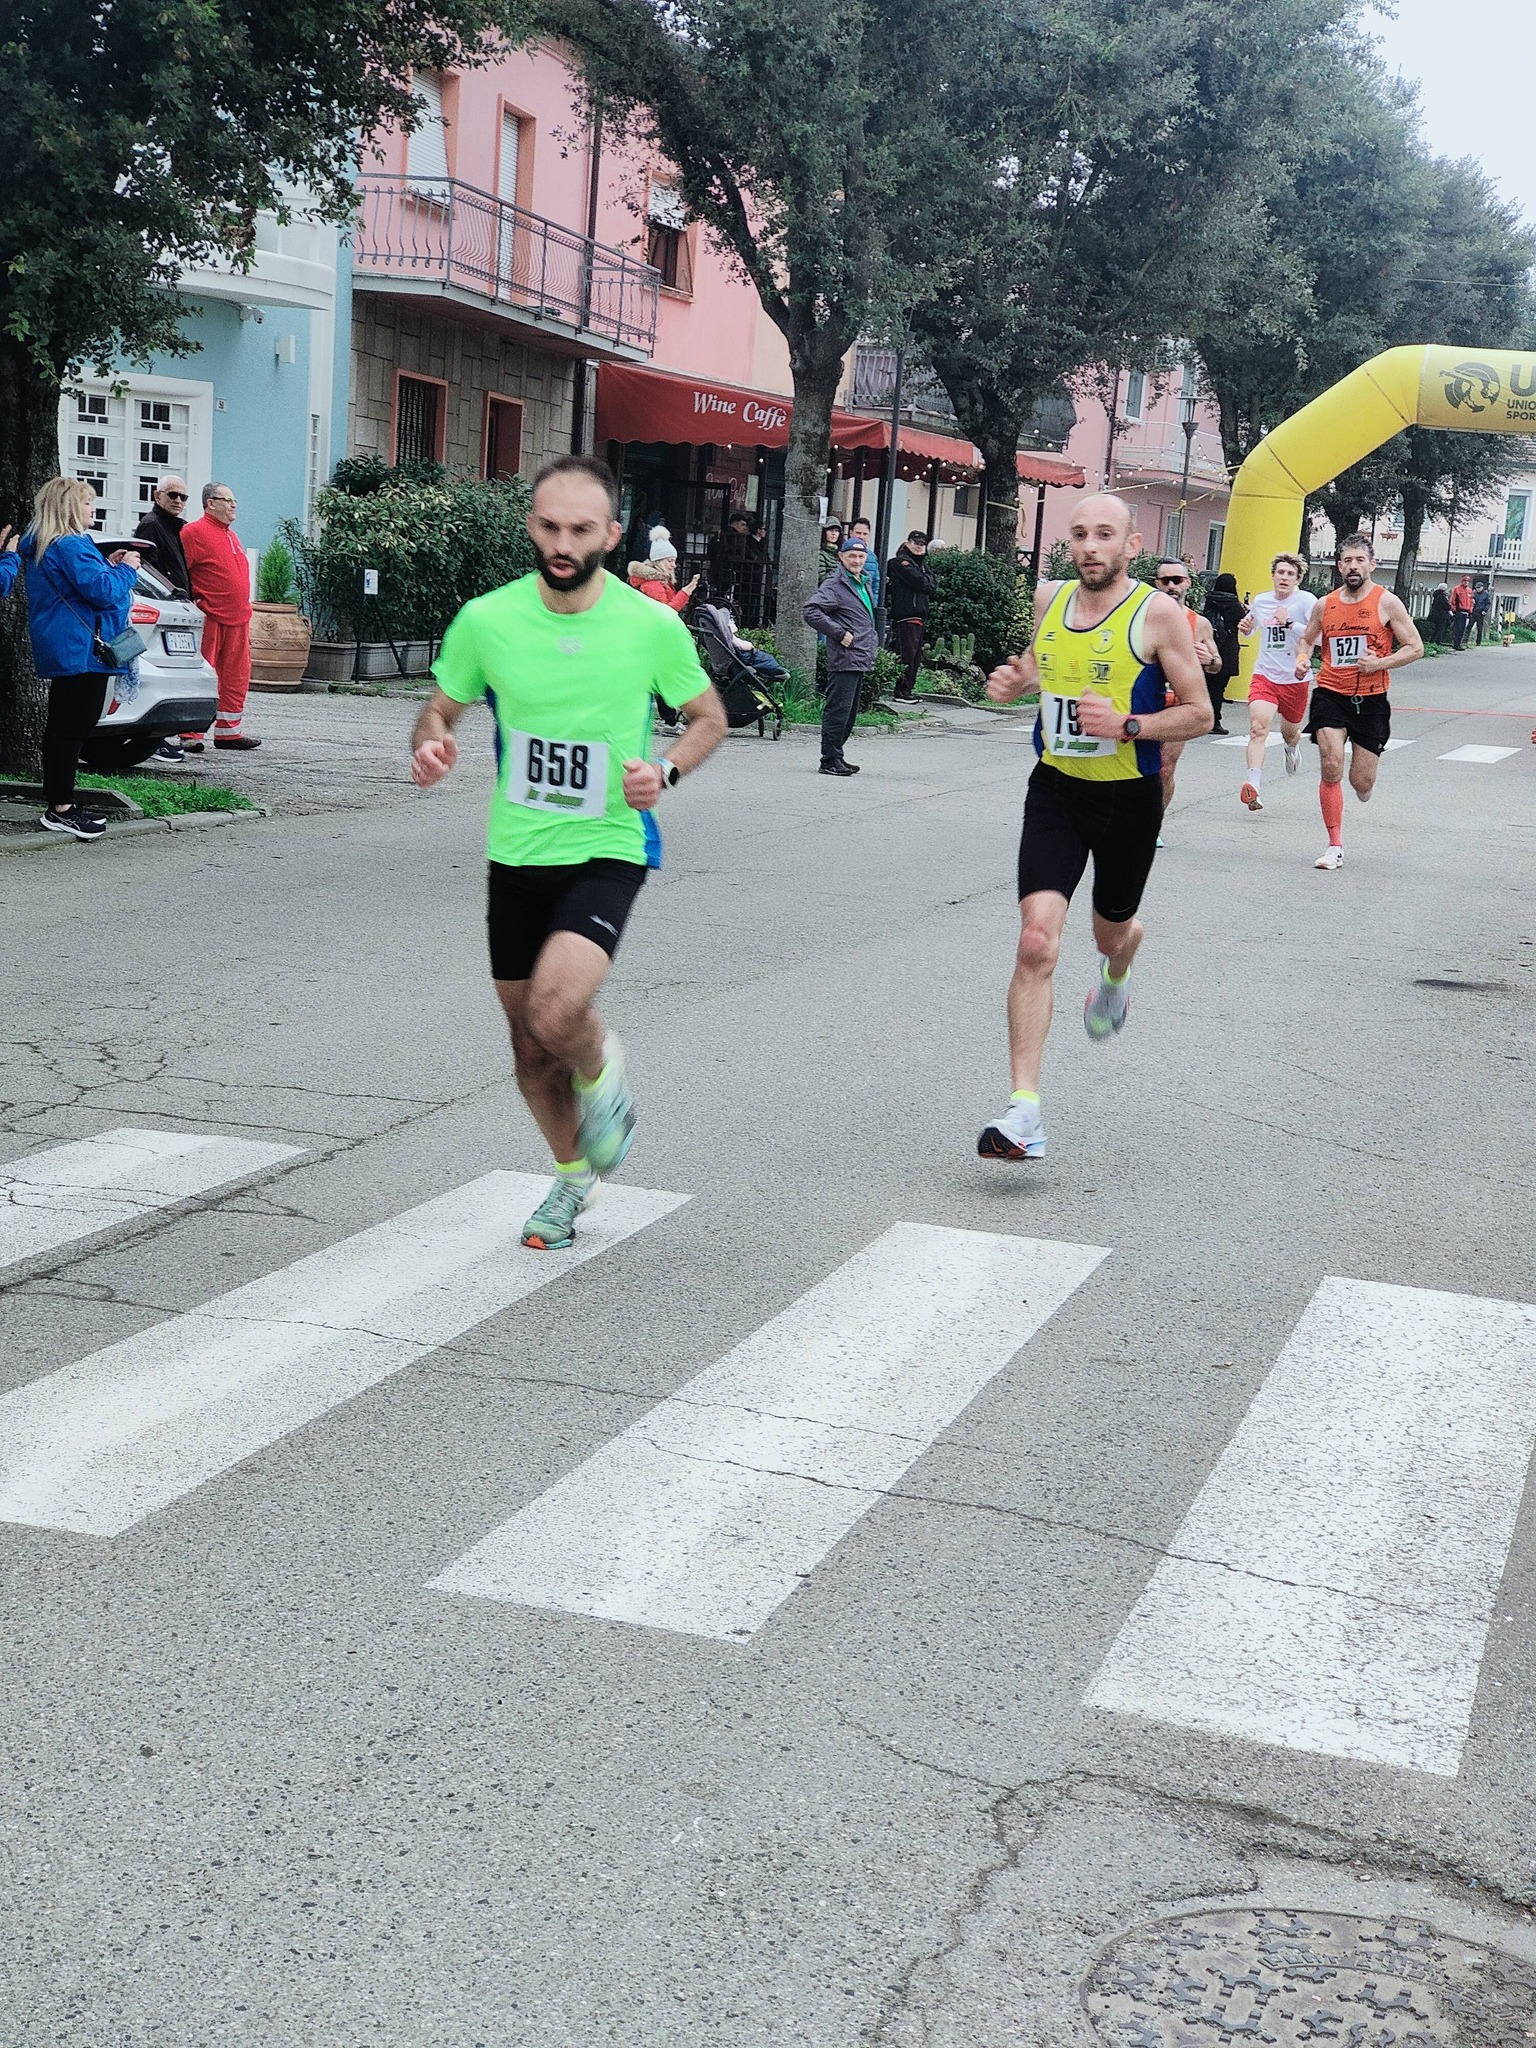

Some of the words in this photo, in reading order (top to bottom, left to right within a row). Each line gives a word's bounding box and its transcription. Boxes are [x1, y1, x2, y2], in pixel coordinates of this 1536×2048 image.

[693, 391, 737, 414] Wine
[742, 401, 788, 430] Caffè
[1267, 626, 1285, 642] 795
[1336, 637, 1359, 656] 527
[1053, 697, 1092, 737] 79
[528, 738, 588, 790] 658
